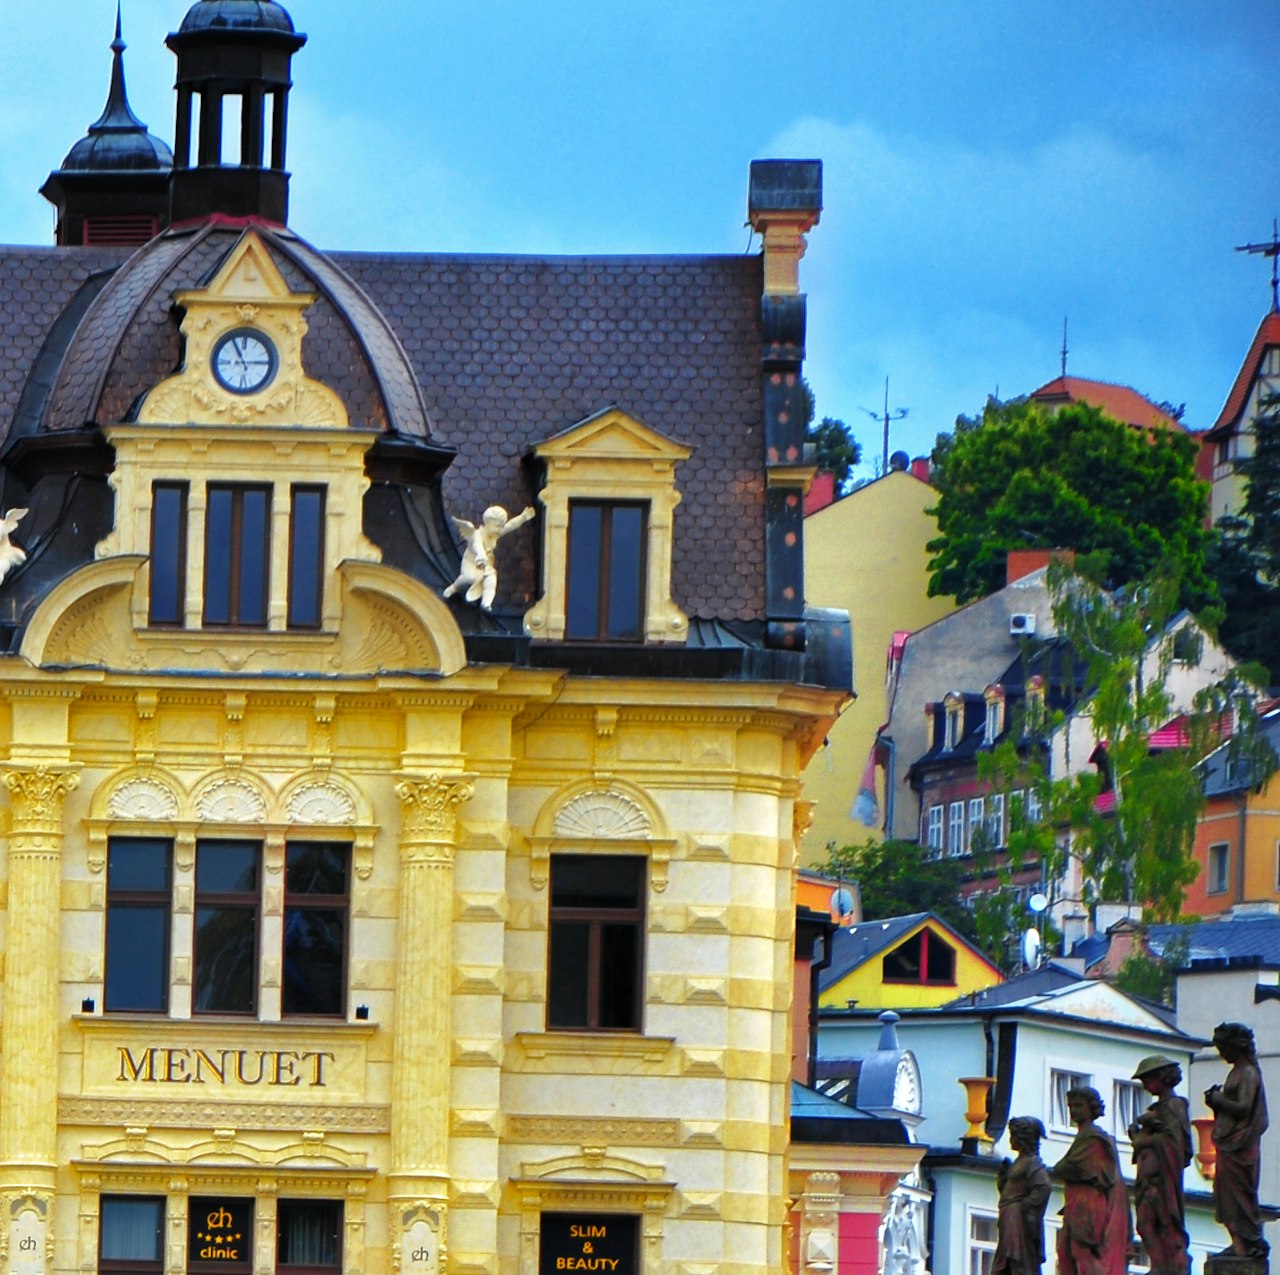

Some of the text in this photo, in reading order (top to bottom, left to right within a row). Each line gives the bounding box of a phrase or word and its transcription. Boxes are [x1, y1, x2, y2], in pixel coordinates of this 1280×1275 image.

[116, 1046, 336, 1087] MENUET
[570, 1225, 606, 1238] SLIM
[200, 1246, 238, 1259] clinic
[582, 1241, 594, 1254] &
[556, 1257, 619, 1271] BEAUTY
